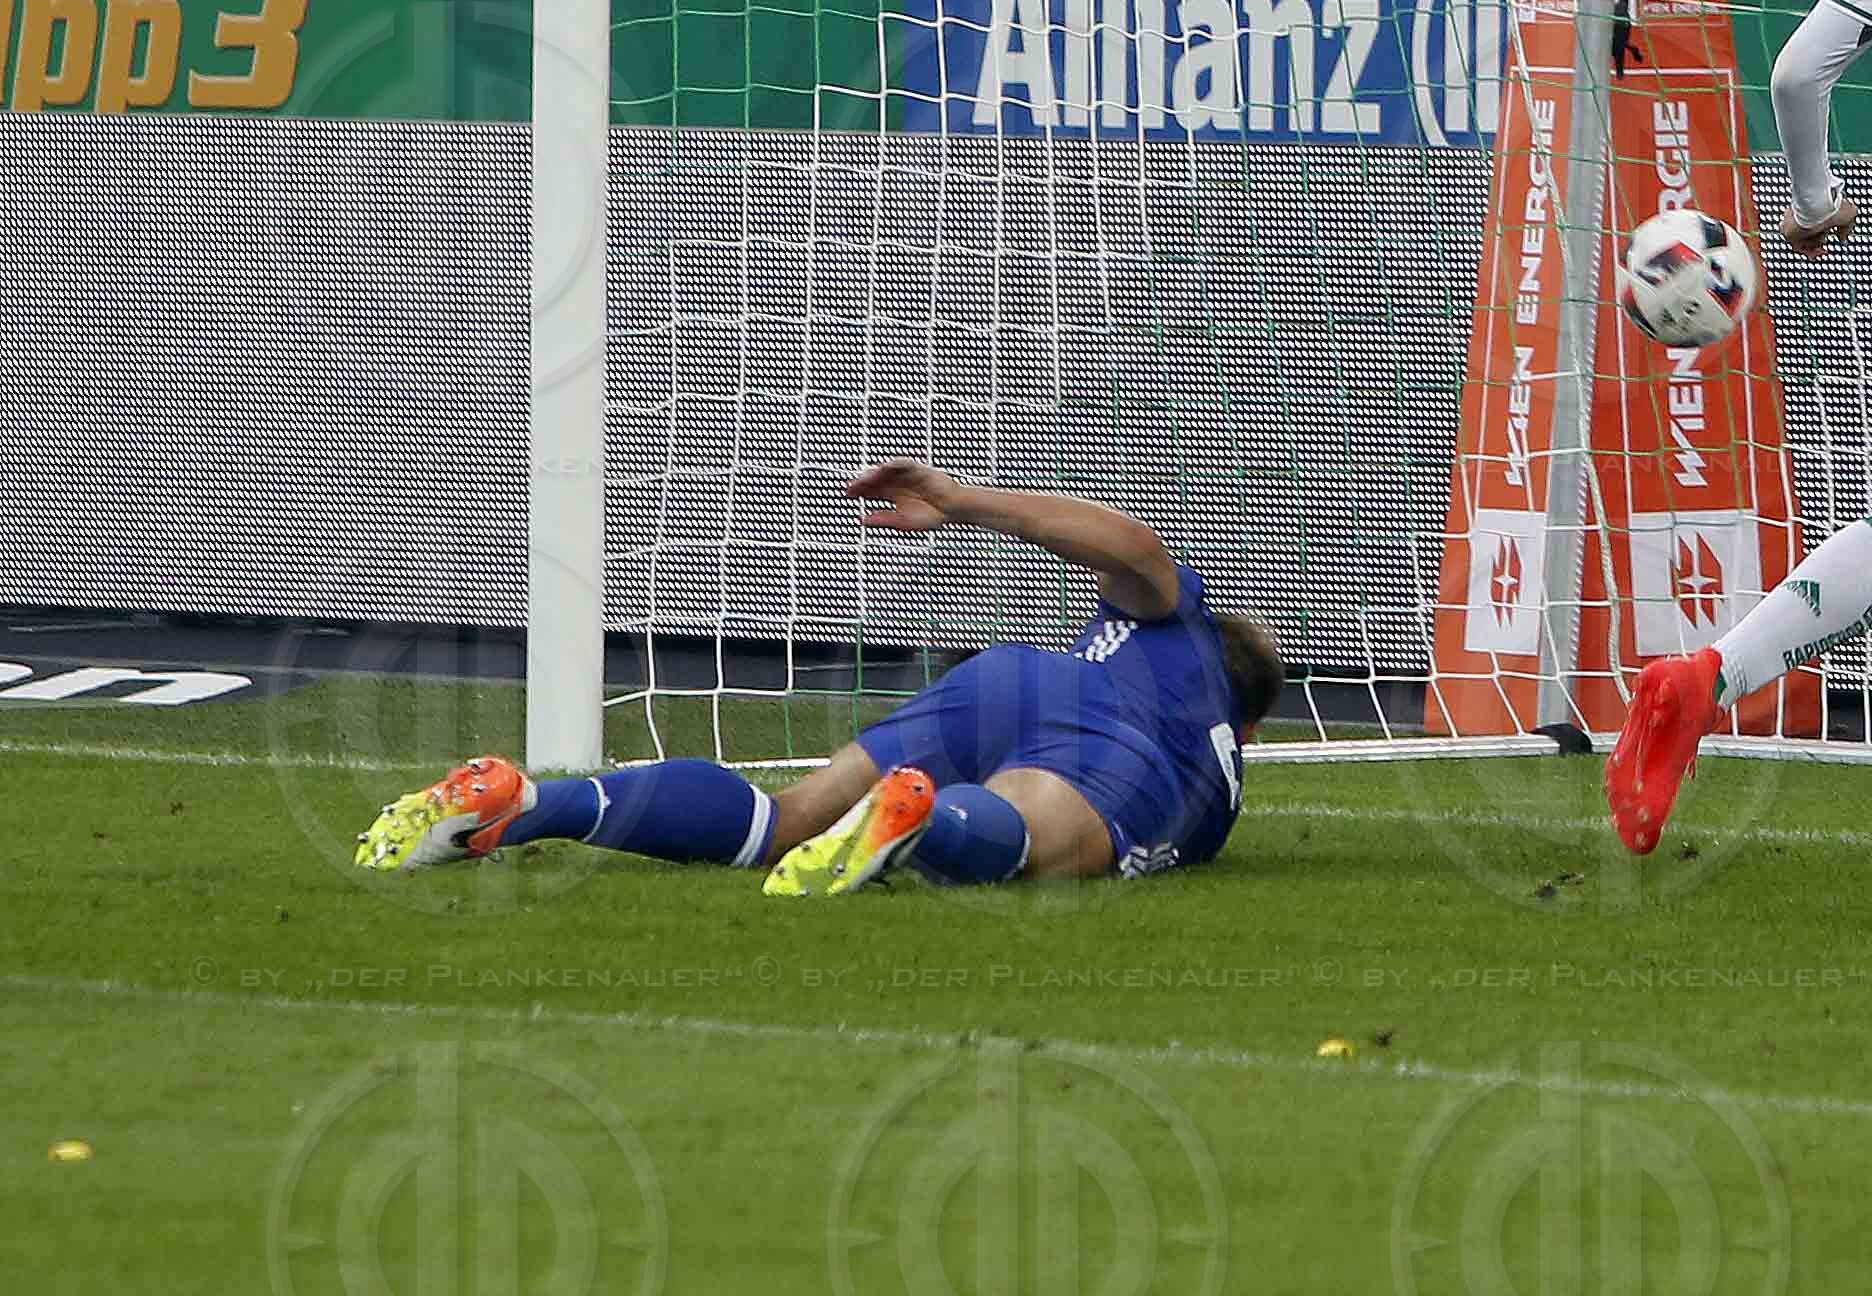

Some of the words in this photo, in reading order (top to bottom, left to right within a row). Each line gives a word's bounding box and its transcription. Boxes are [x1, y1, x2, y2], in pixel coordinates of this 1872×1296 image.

[1515, 99, 1556, 326] ENERGIE
[1505, 345, 1536, 487] WIEN
[1667, 347, 1708, 488] WIEN
